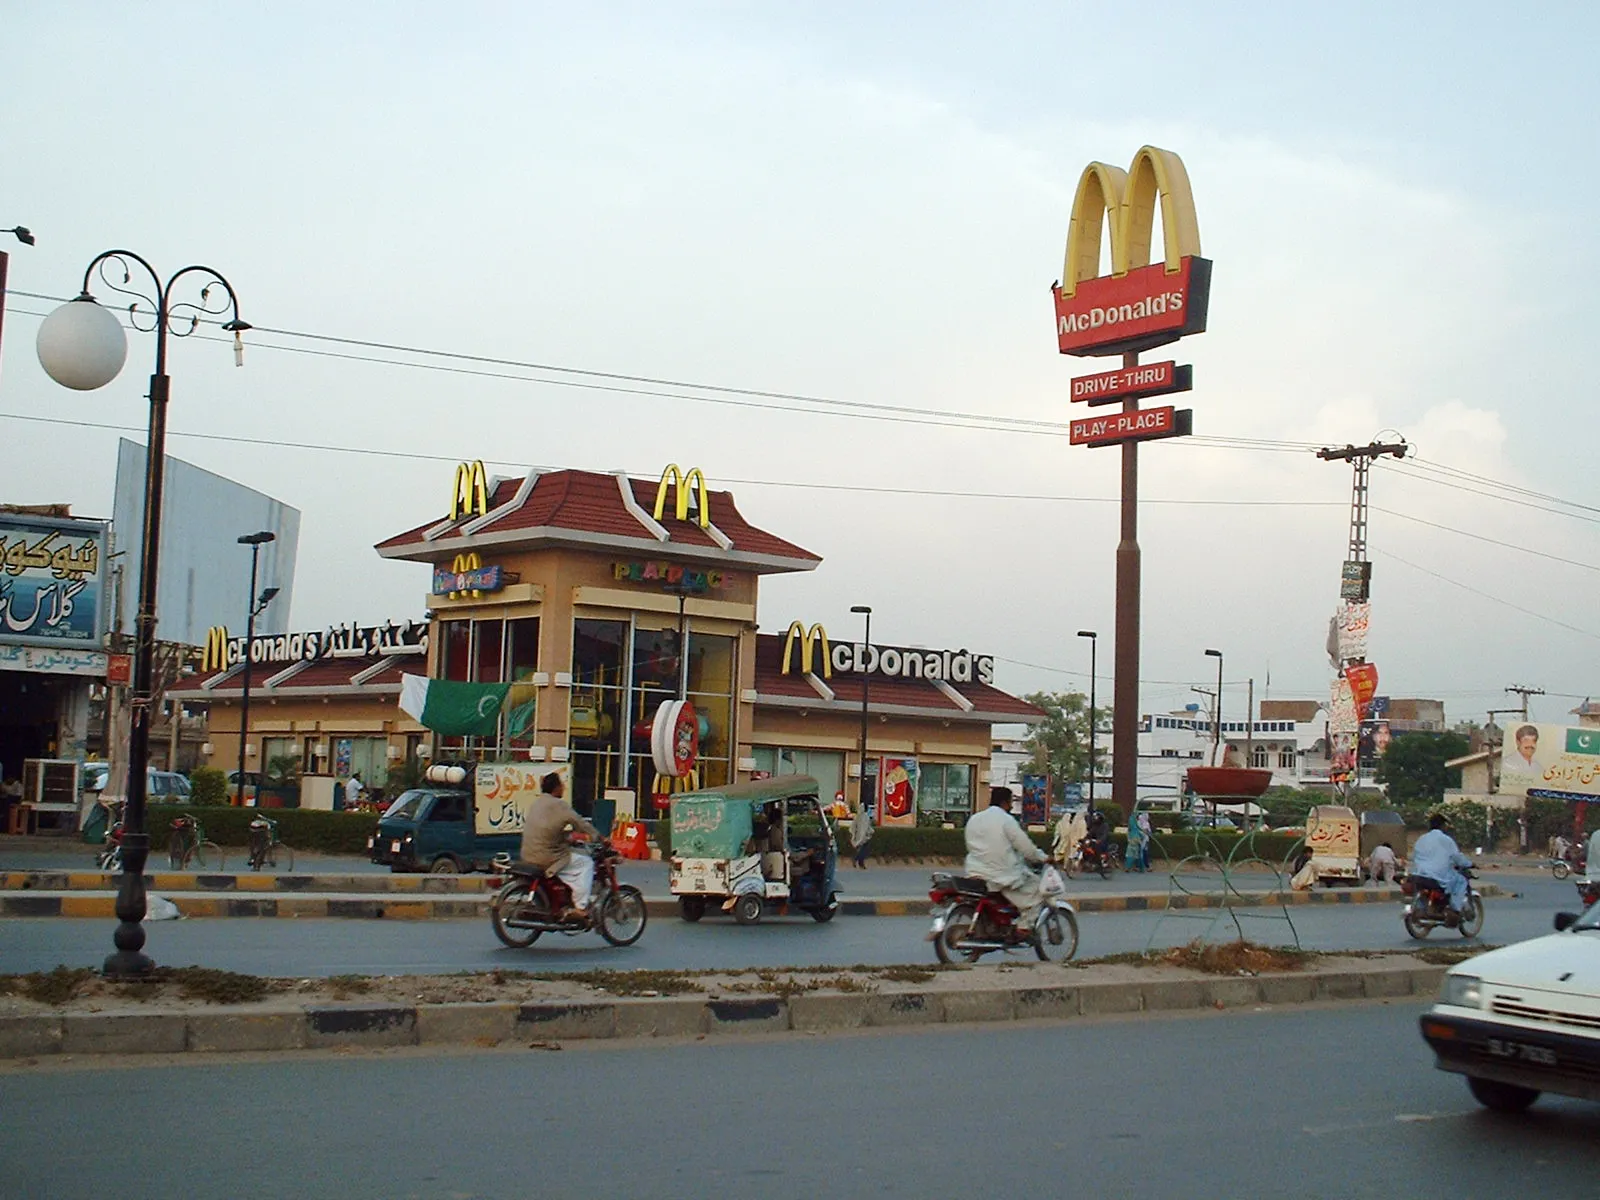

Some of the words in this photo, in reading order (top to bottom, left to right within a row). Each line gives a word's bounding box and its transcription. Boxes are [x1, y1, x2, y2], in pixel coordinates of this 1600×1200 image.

[1059, 292, 1184, 335] McDonald's
[1074, 367, 1166, 396] DRIVE-THRU
[1073, 412, 1165, 438] PLAY-PLACE
[202, 625, 317, 673] McDonald's
[782, 620, 994, 684] McDonald's
